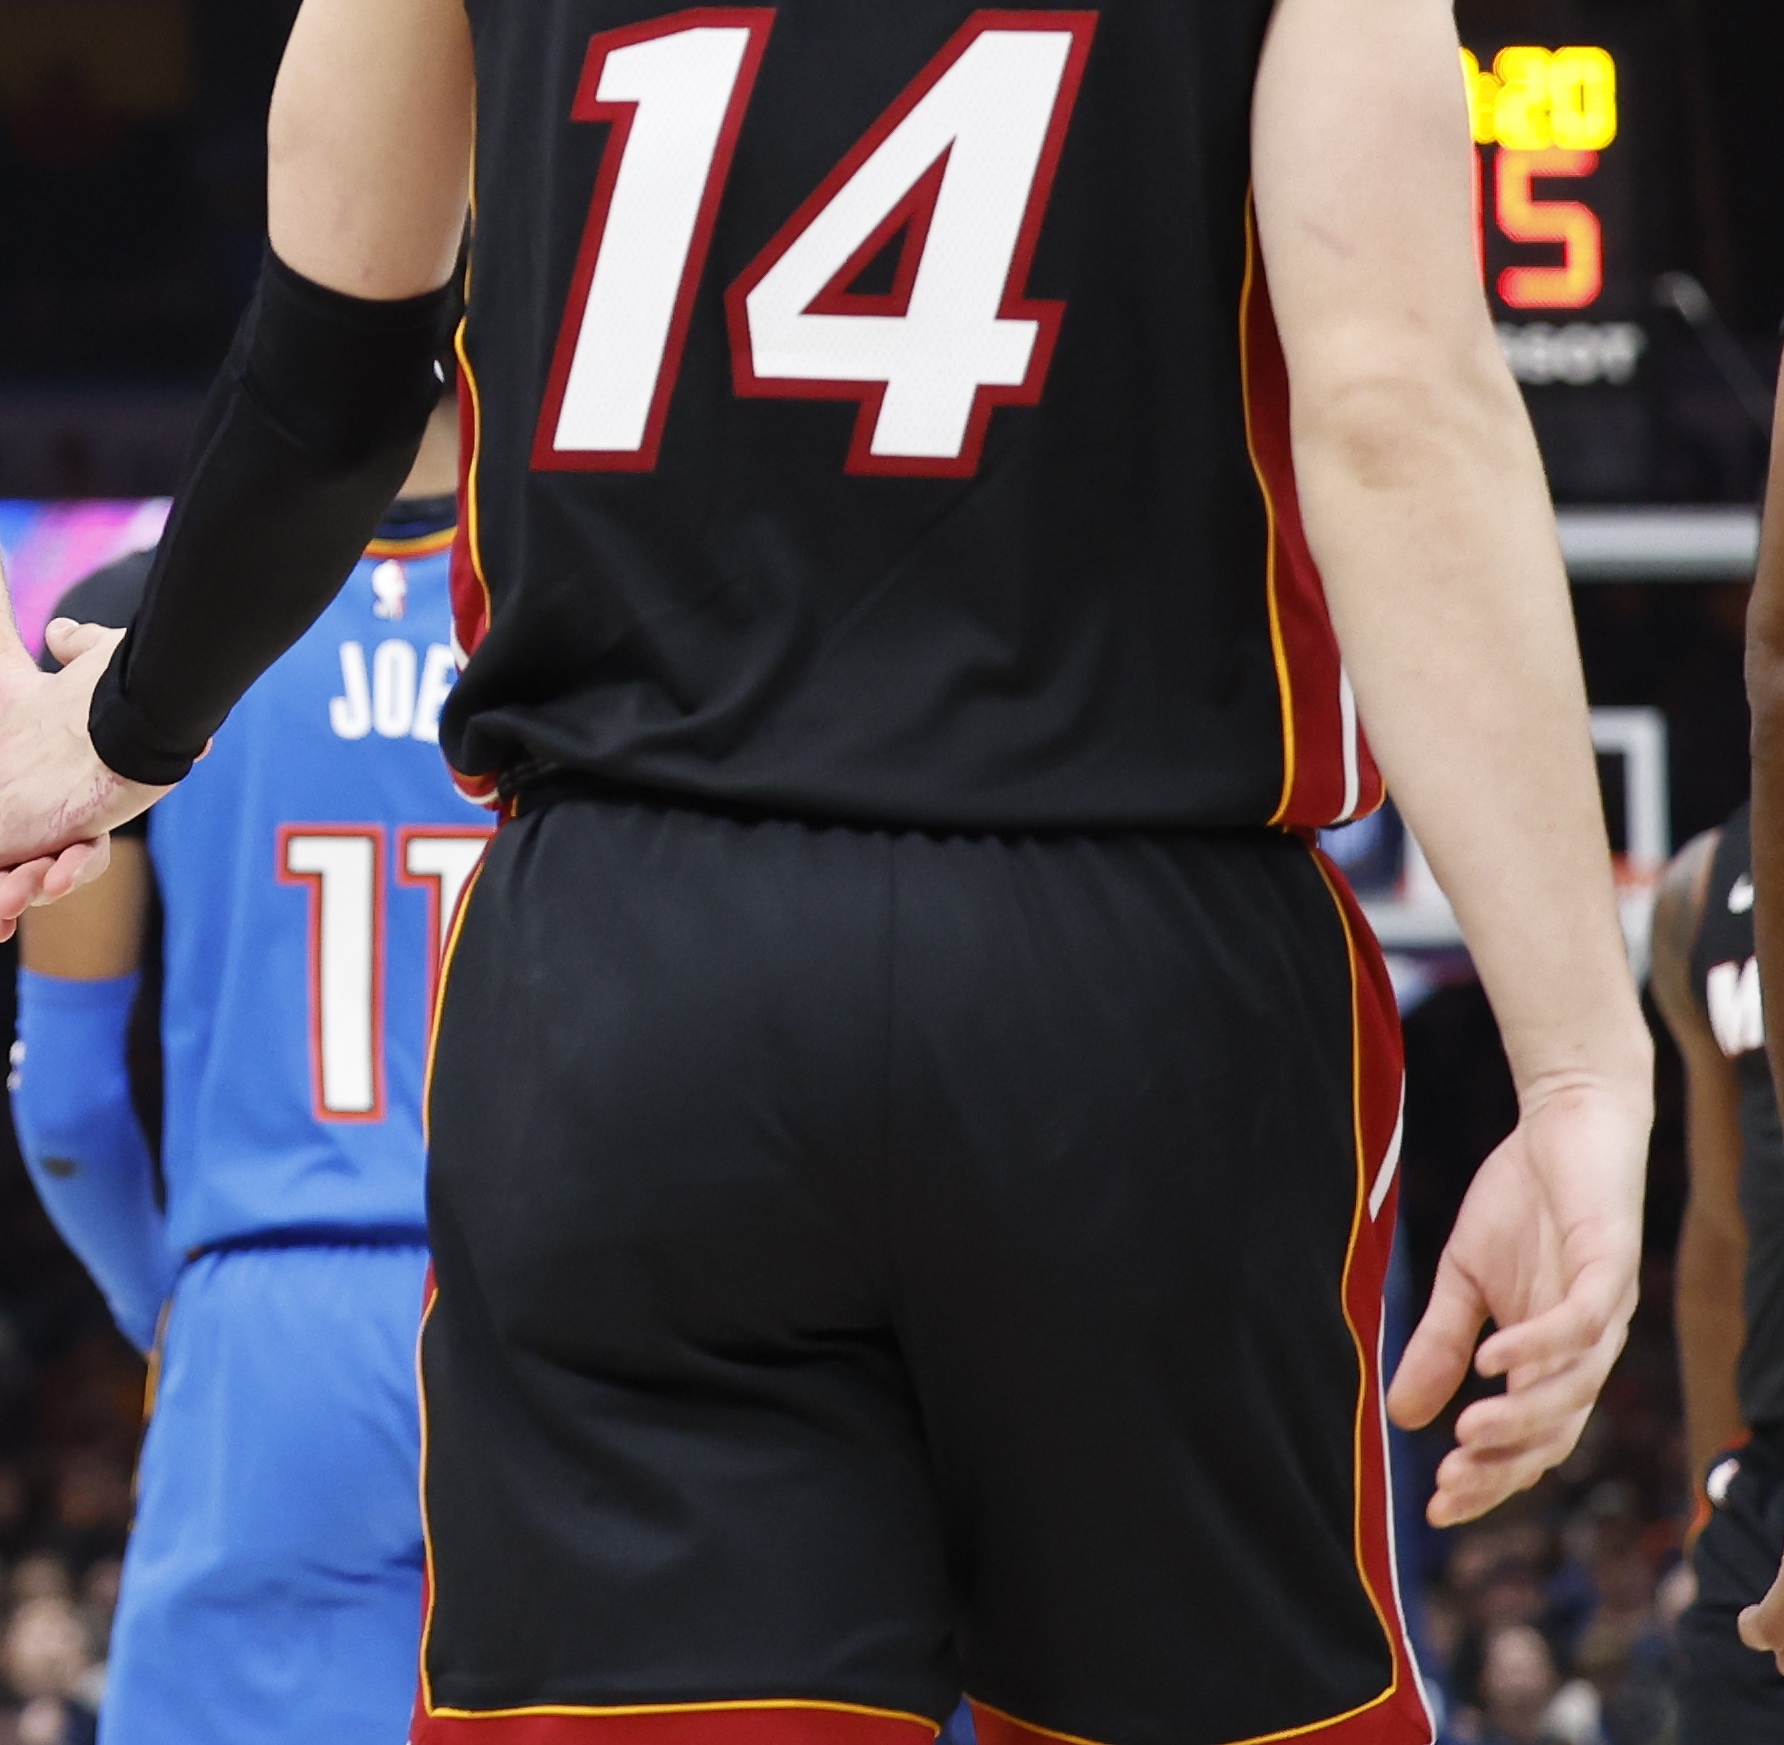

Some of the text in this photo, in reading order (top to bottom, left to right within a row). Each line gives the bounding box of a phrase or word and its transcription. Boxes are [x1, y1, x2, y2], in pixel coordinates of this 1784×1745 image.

[1460, 46, 1617, 150] :20
[529, 6, 1100, 477] 14
[1470, 147, 1604, 310] 5
